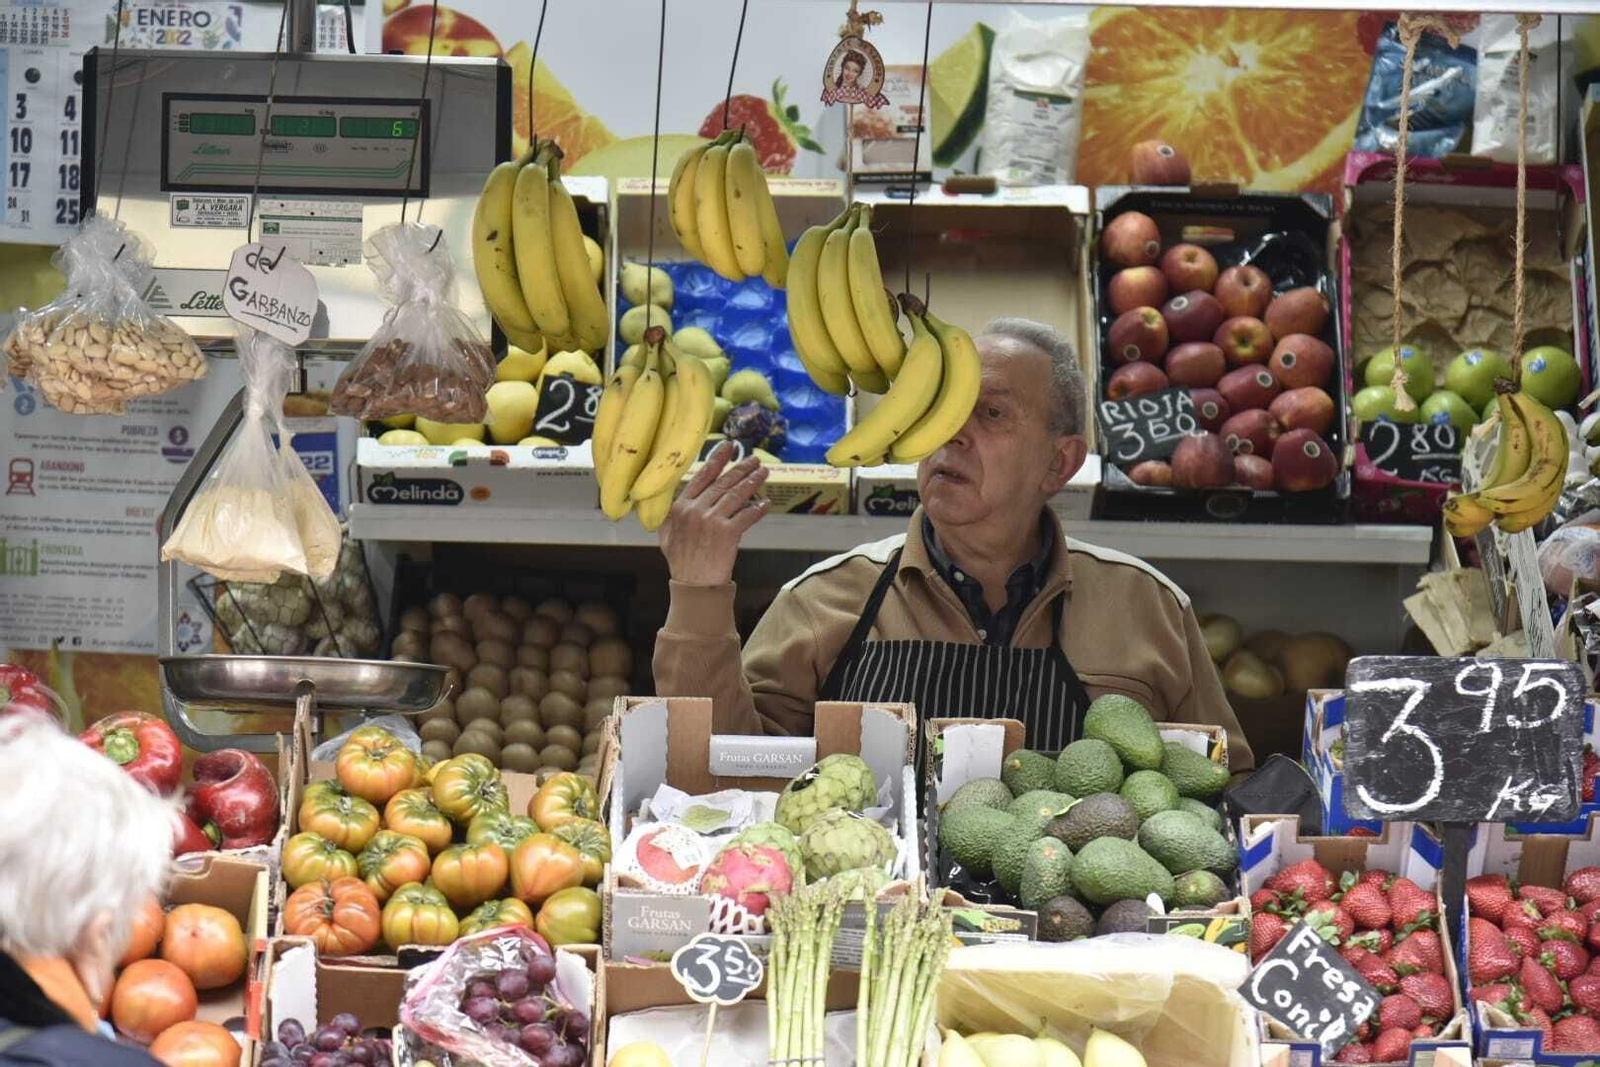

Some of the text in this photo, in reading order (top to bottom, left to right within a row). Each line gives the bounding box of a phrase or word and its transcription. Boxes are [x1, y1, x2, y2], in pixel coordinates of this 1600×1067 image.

[137, 9, 212, 28] ENERO
[156, 29, 192, 45] 2022
[16, 93, 76, 121] 3 4
[11, 127, 79, 155] 10 11
[10, 162, 79, 190] 17 18
[21, 209, 30, 222] 31
[56, 198, 79, 225] 25
[210, 203, 244, 213] VERGARA
[245, 245, 286, 275] del
[228, 275, 311, 327] GARBANZO
[535, 378, 575, 433] 2
[1100, 390, 1195, 425] RIOJA
[121, 424, 159, 437] POBREZA
[1110, 421, 1145, 461] 3
[1369, 420, 1456, 477] 2 80
[40, 460, 86, 474] ABANDONO
[371, 483, 460, 500] Melinda
[125, 506, 156, 518] BREXIT
[40, 544, 85, 556] FRONTERA
[1350, 660, 1570, 814] 3 95
[719, 751, 804, 765] Frutas GARSAN
[627, 916, 693, 931] GARSAN
[639, 905, 681, 919] Frutas
[682, 943, 722, 995] 3
[1286, 925, 1376, 1026] Fresa
